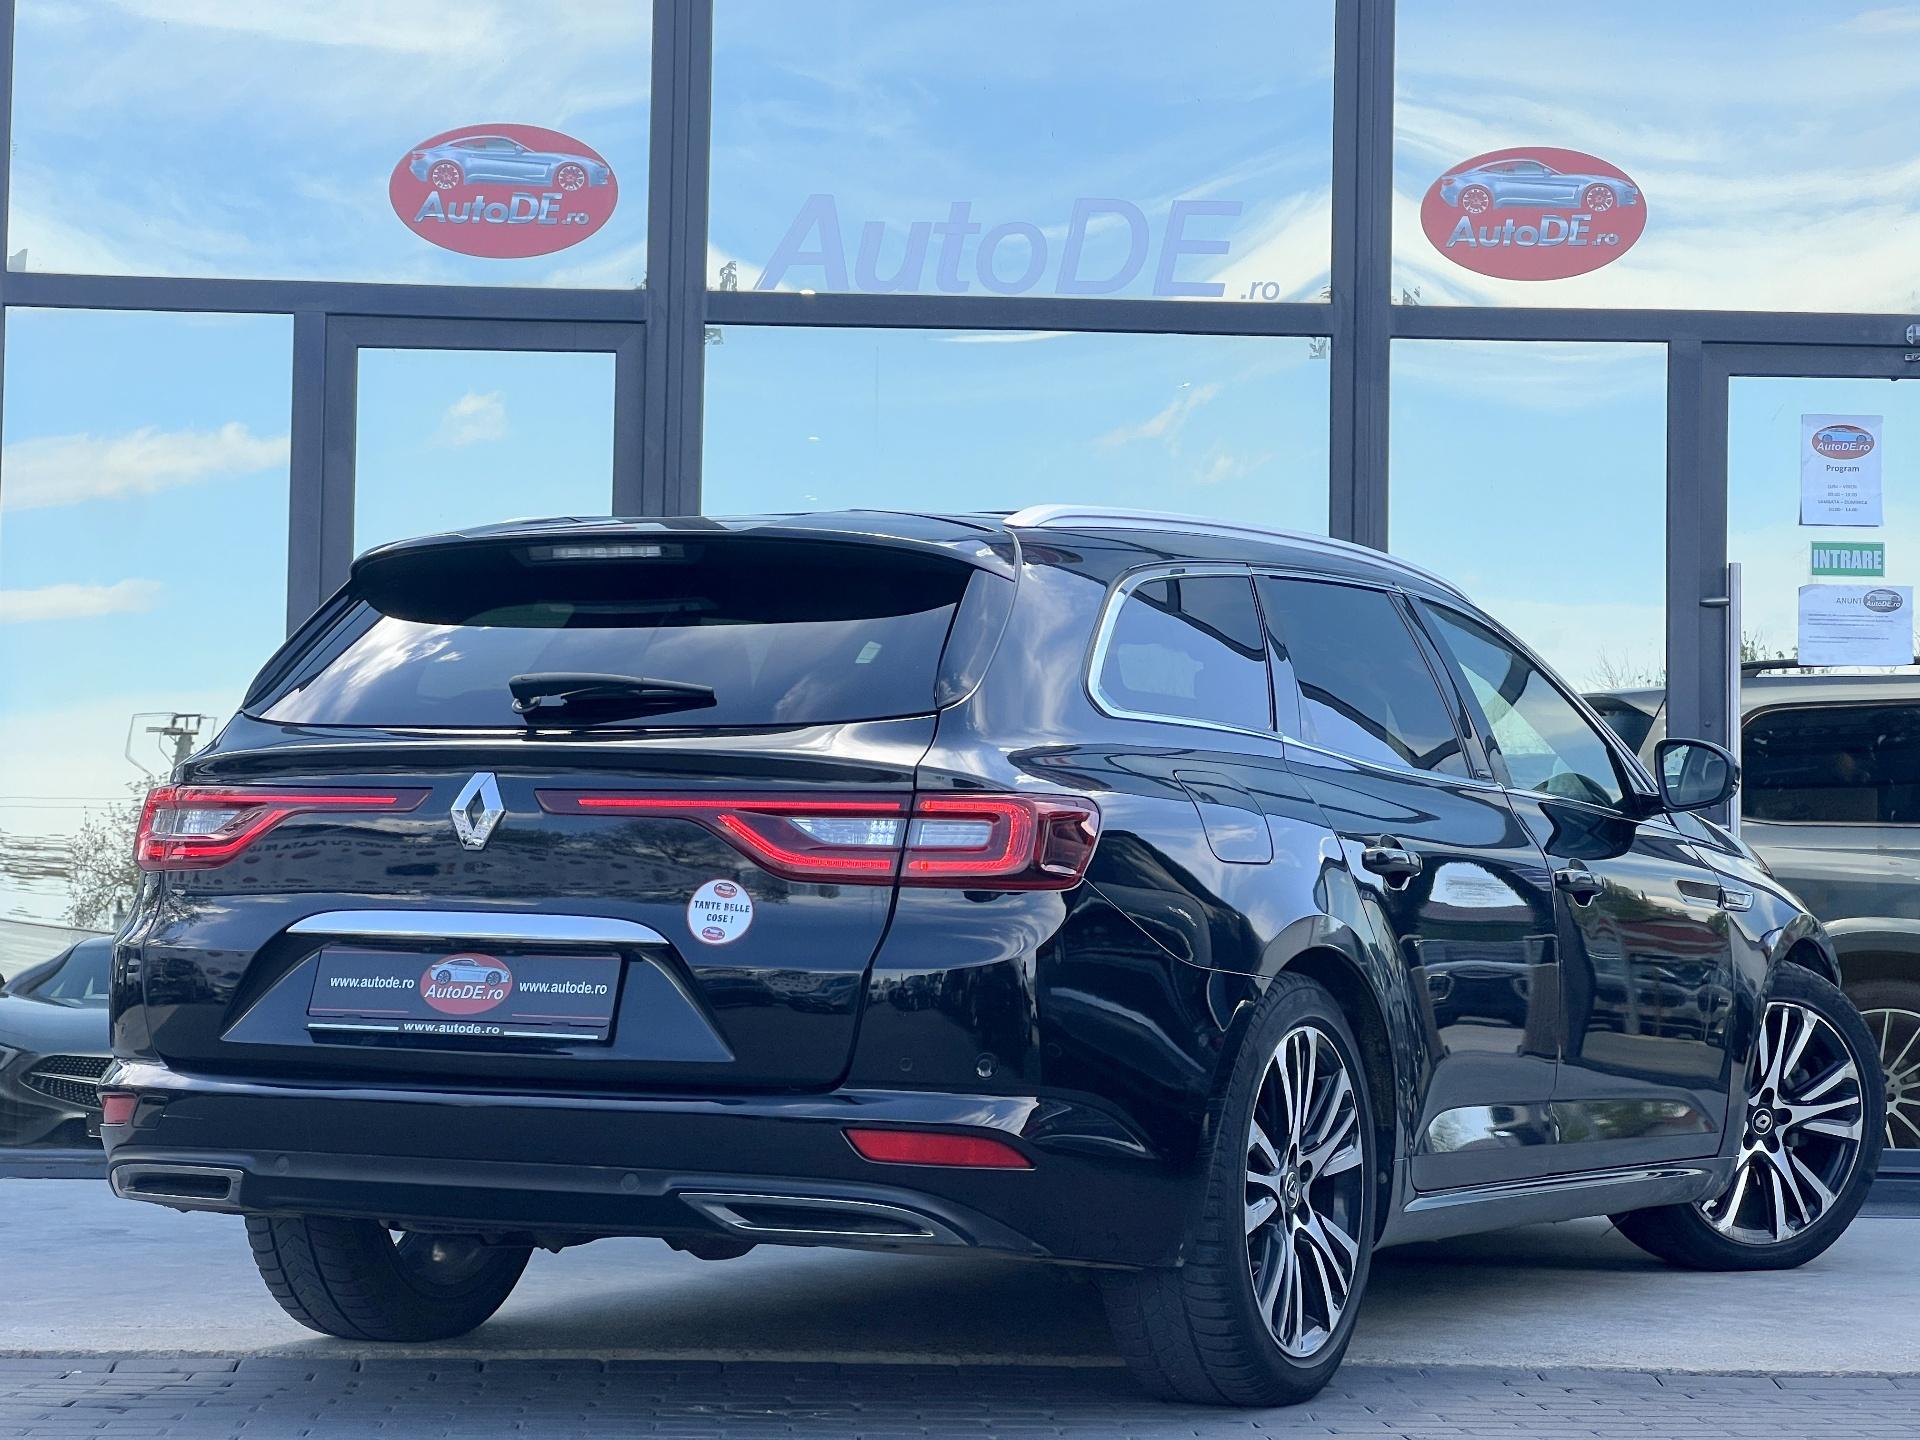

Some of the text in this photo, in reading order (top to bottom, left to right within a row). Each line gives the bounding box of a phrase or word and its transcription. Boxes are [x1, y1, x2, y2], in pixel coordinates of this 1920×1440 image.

[1816, 442, 1871, 451] AutoDE.ro
[1826, 464, 1860, 473] Program
[1813, 549, 1882, 569] INTRARE
[694, 900, 751, 913] TANTE BELLE
[706, 913, 728, 923] COSE
[330, 976, 415, 989] www.autode.ro
[519, 981, 608, 995] www.autode.ro
[424, 984, 504, 1000] AutoDE.ro
[403, 1023, 500, 1034] www.autode.ro
